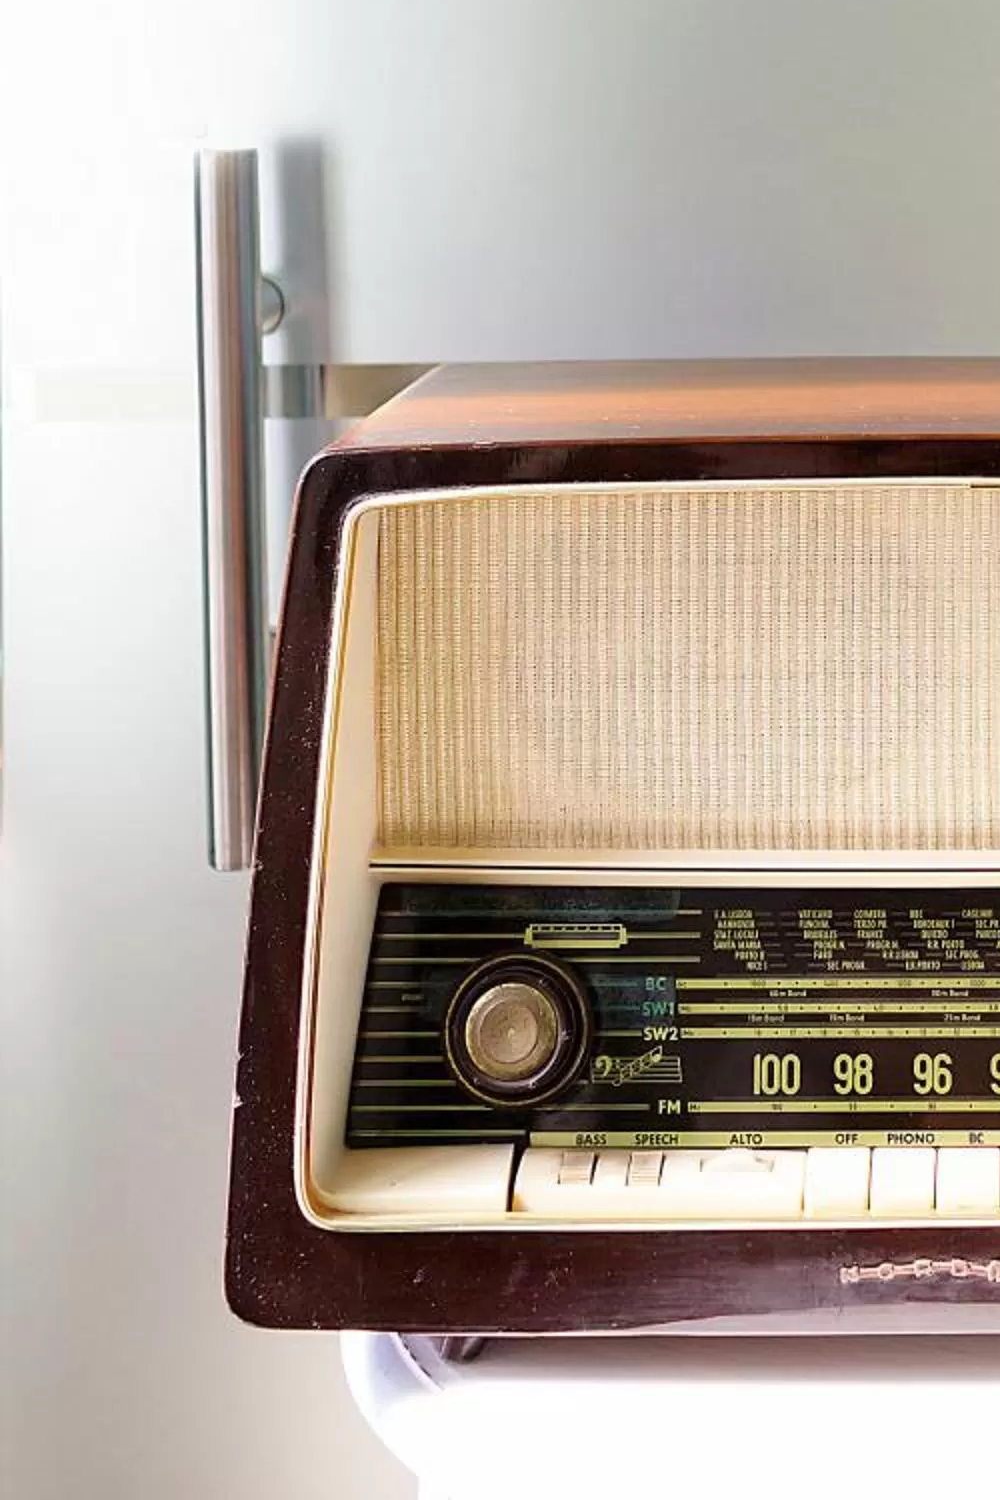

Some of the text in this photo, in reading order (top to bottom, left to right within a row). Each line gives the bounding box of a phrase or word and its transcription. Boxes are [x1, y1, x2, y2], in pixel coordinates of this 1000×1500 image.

[645, 977, 667, 991] BC
[642, 1001, 675, 1016] SW1
[643, 1026, 679, 1041] SW2
[752, 1053, 801, 1096] 100
[832, 1053, 874, 1096] 98
[912, 1053, 954, 1096] 96
[658, 1100, 681, 1115] FM
[575, 1133, 608, 1146] BASS
[635, 1133, 679, 1146] SPEECH
[729, 1133, 763, 1145] ALTO
[835, 1133, 859, 1145] OFF
[887, 1133, 935, 1145] PHONO
[969, 1133, 984, 1144] BC
